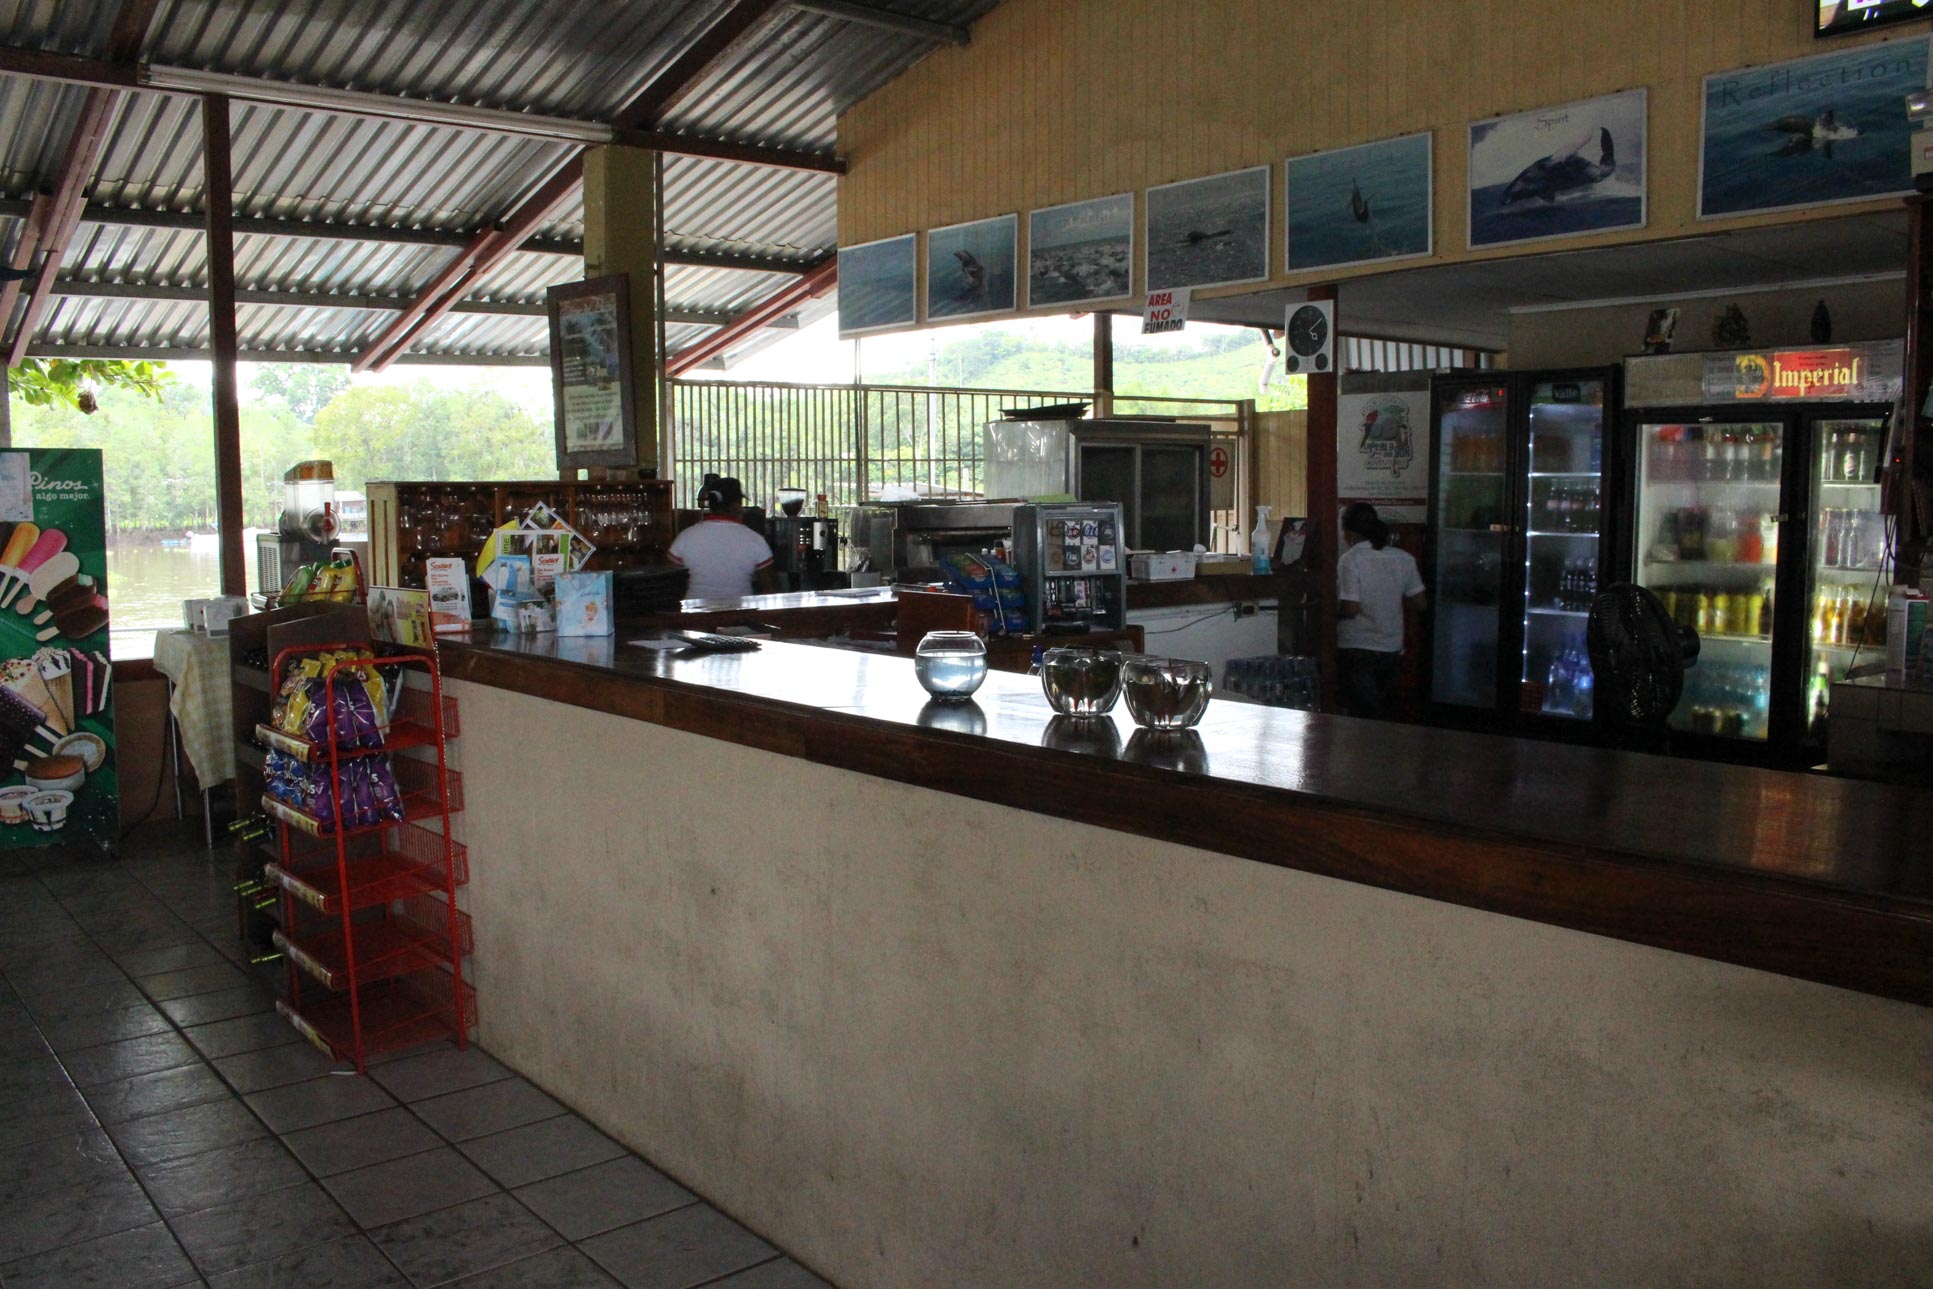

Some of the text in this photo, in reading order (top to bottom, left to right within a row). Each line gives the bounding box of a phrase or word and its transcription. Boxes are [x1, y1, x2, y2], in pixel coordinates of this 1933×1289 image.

[1721, 59, 1909, 107] Reflection
[1535, 113, 1569, 132] Spirit
[1147, 292, 1173, 308] AREA
[1150, 309, 1171, 322] NO
[1144, 318, 1183, 333] FUMADO
[1773, 356, 1861, 397] Imperial
[35, 491, 58, 502] algo
